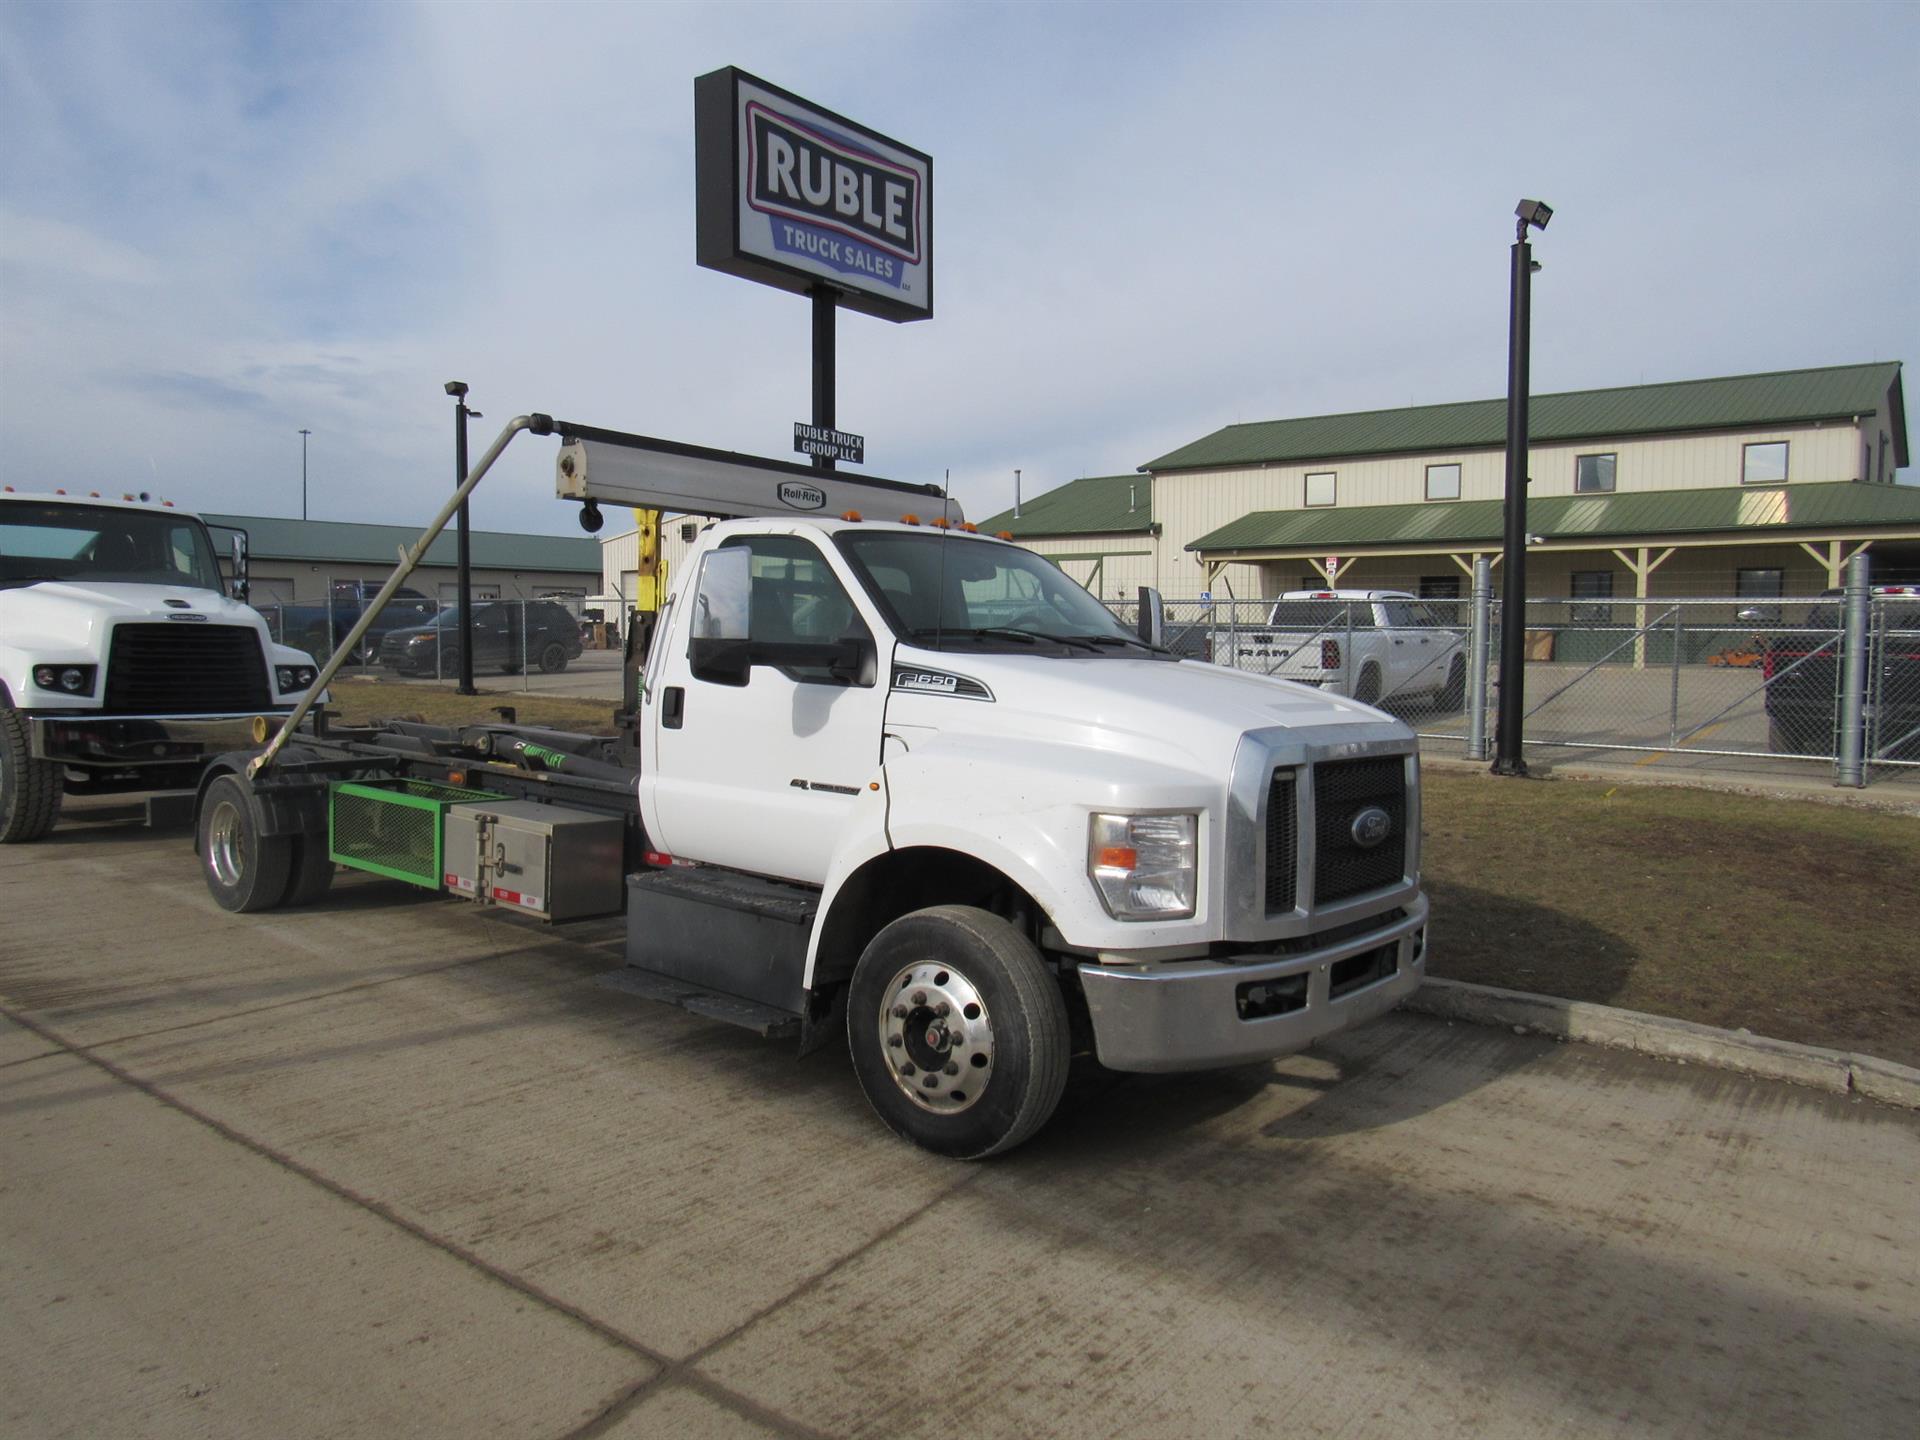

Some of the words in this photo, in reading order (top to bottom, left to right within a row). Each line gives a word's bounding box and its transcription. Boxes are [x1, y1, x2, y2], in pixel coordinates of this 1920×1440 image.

[767, 131, 907, 239] RUBLE
[784, 226, 841, 262] TRUCK
[845, 246, 893, 278] SALES
[795, 424, 829, 442] RUBLE
[830, 431, 862, 449] TRUCK
[802, 441, 838, 458] GROUP
[840, 447, 857, 461] LLC
[783, 487, 821, 503] Roll-Rite
[1239, 649, 1289, 657] RAM
